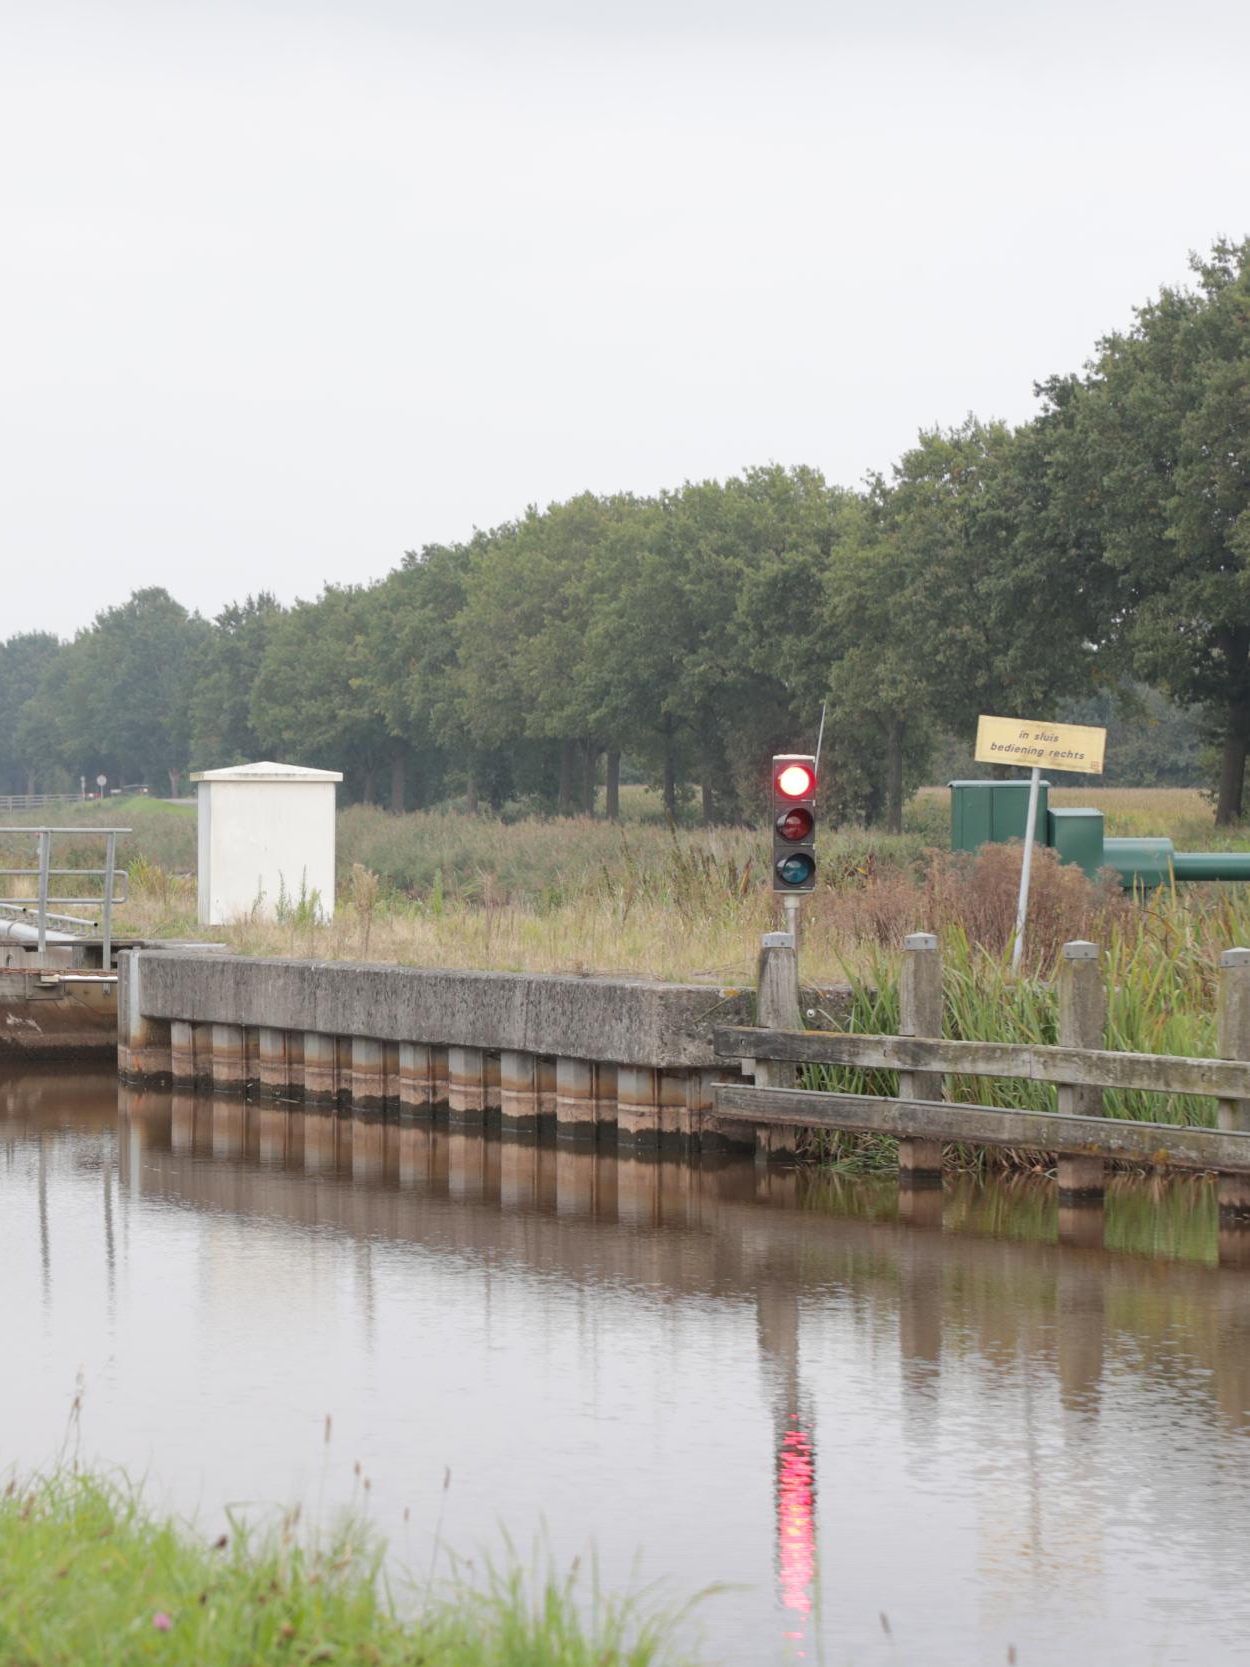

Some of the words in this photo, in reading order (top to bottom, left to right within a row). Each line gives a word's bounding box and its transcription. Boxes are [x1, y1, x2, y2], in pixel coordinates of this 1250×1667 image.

[1018, 730, 1030, 739] in
[1034, 732, 1060, 743] sluis
[990, 742, 1045, 758] bediening
[1048, 749, 1086, 760] rechts
